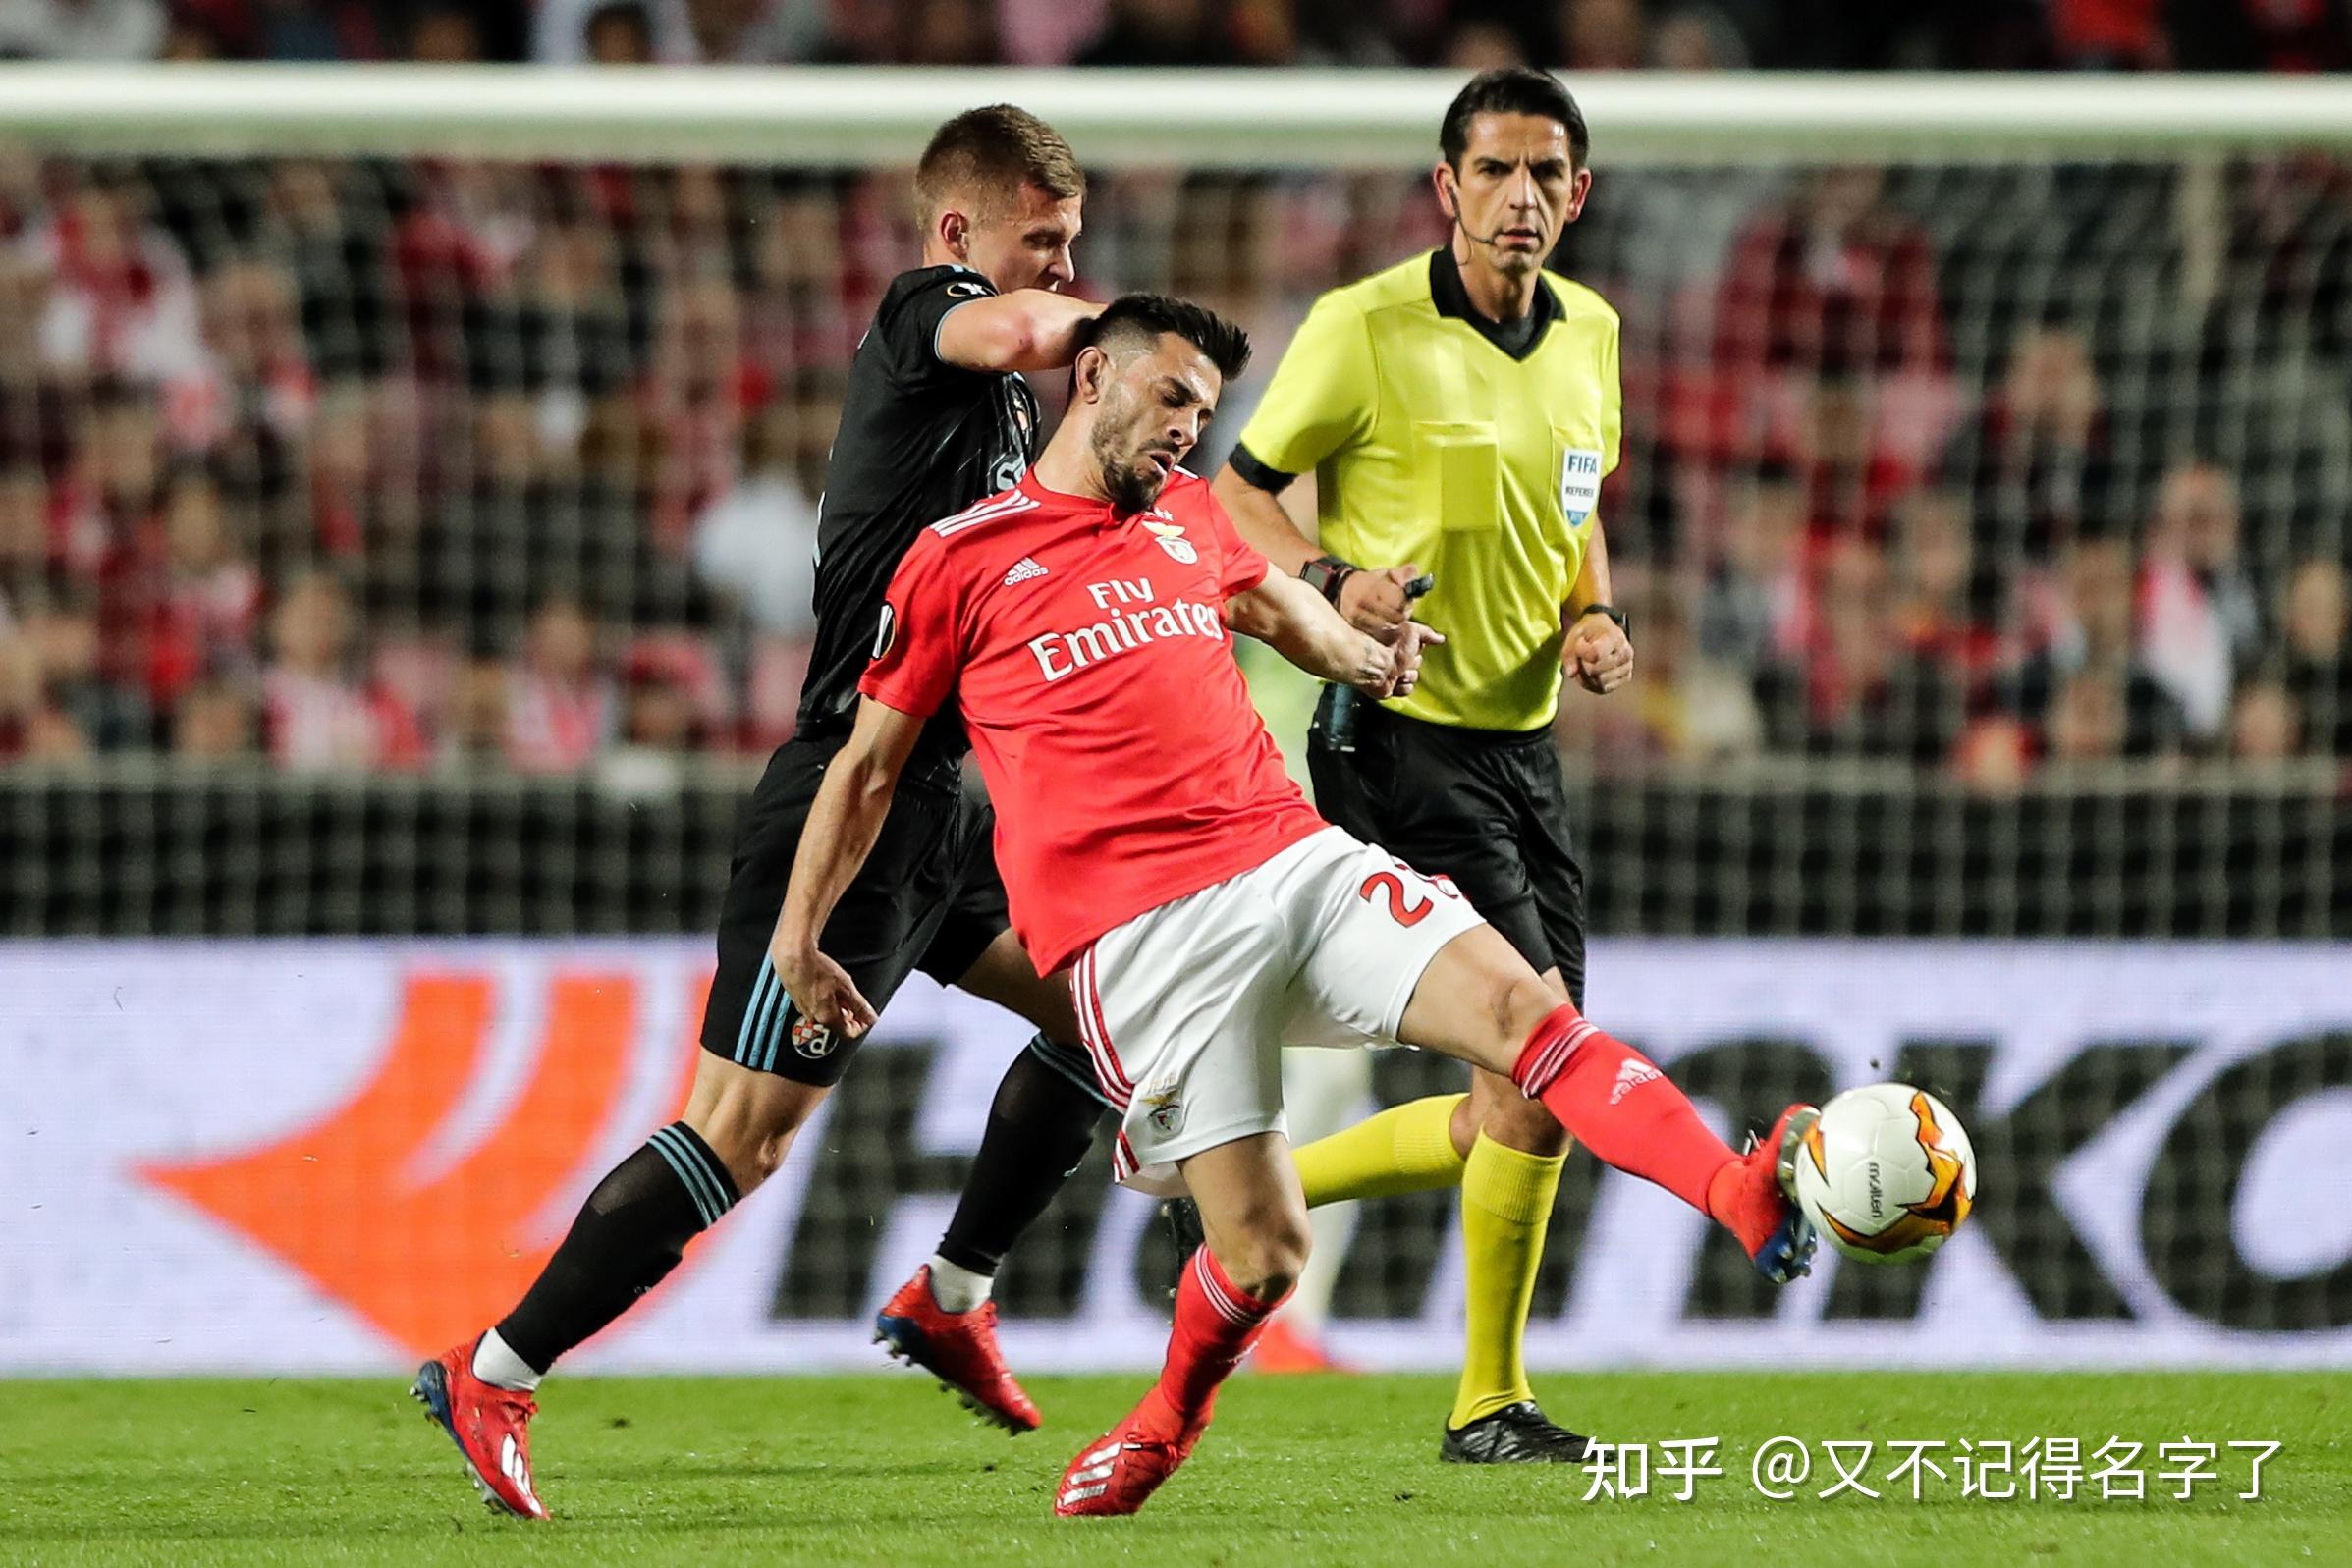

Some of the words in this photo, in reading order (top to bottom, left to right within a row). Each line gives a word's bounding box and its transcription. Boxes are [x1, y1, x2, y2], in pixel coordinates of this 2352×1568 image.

[1567, 455, 1597, 474] FIFA
[1004, 567, 1049, 586] adidas
[1086, 577, 1155, 609] Fly
[1027, 597, 1224, 682] Emirates
[1869, 1162, 1885, 1218] molten
